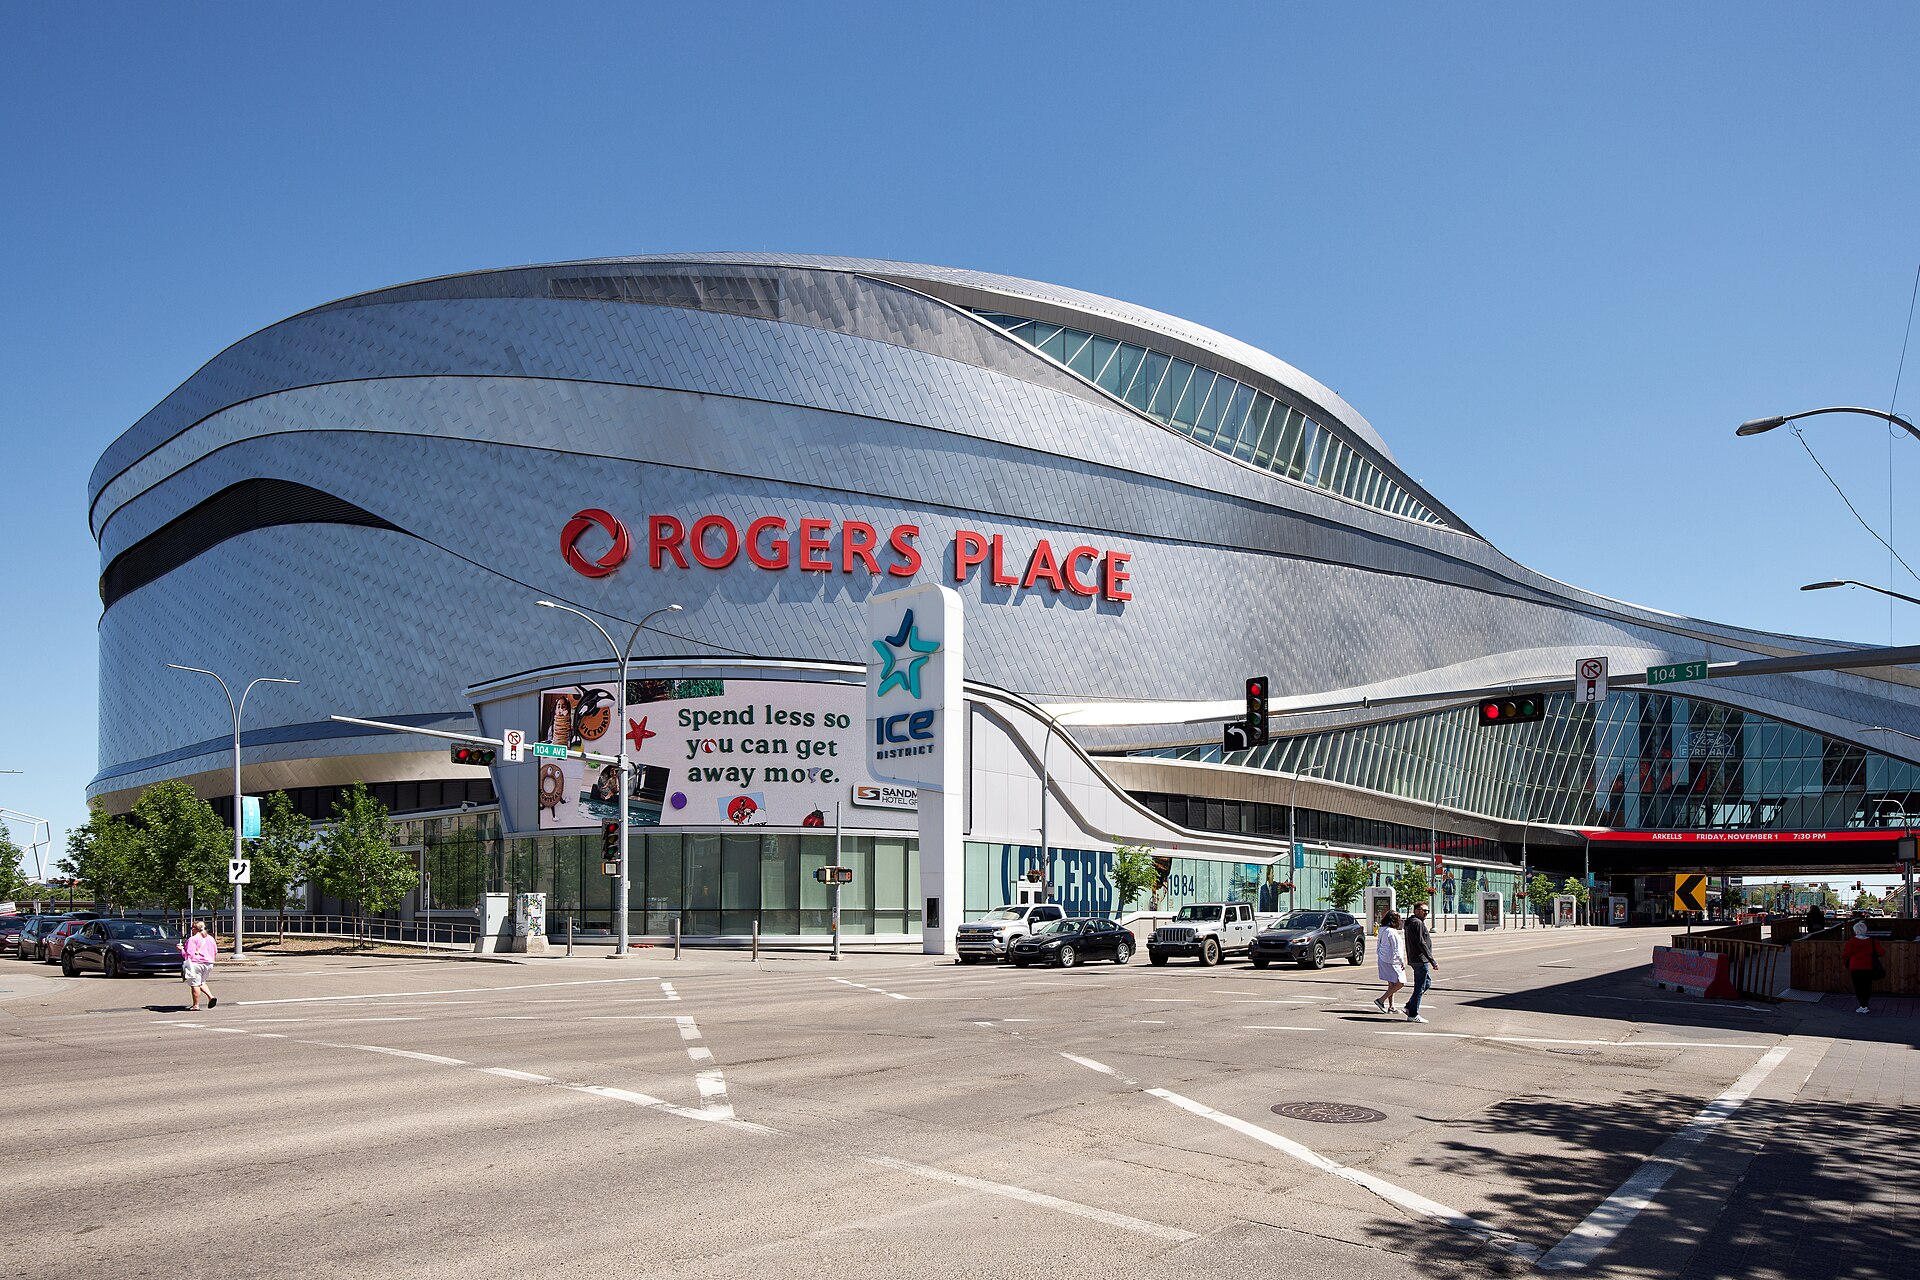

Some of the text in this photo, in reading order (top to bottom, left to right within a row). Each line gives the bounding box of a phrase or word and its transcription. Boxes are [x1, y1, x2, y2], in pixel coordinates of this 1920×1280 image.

[648, 514, 1132, 601] ROGERS PLACE
[1653, 665, 1701, 681] 104 ST
[580, 710, 609, 737] VICTORIA
[678, 704, 851, 731] Spend less so
[535, 746, 565, 757] 104 AVE
[740, 737, 788, 753] can
[796, 739, 838, 759] get
[877, 744, 934, 760] DISTRICT
[688, 766, 756, 787] away
[882, 788, 918, 799] SANDM
[882, 796, 907, 805] HOTEL
[1018, 845, 1114, 918] OLERS
[1168, 874, 1195, 897] 1984
